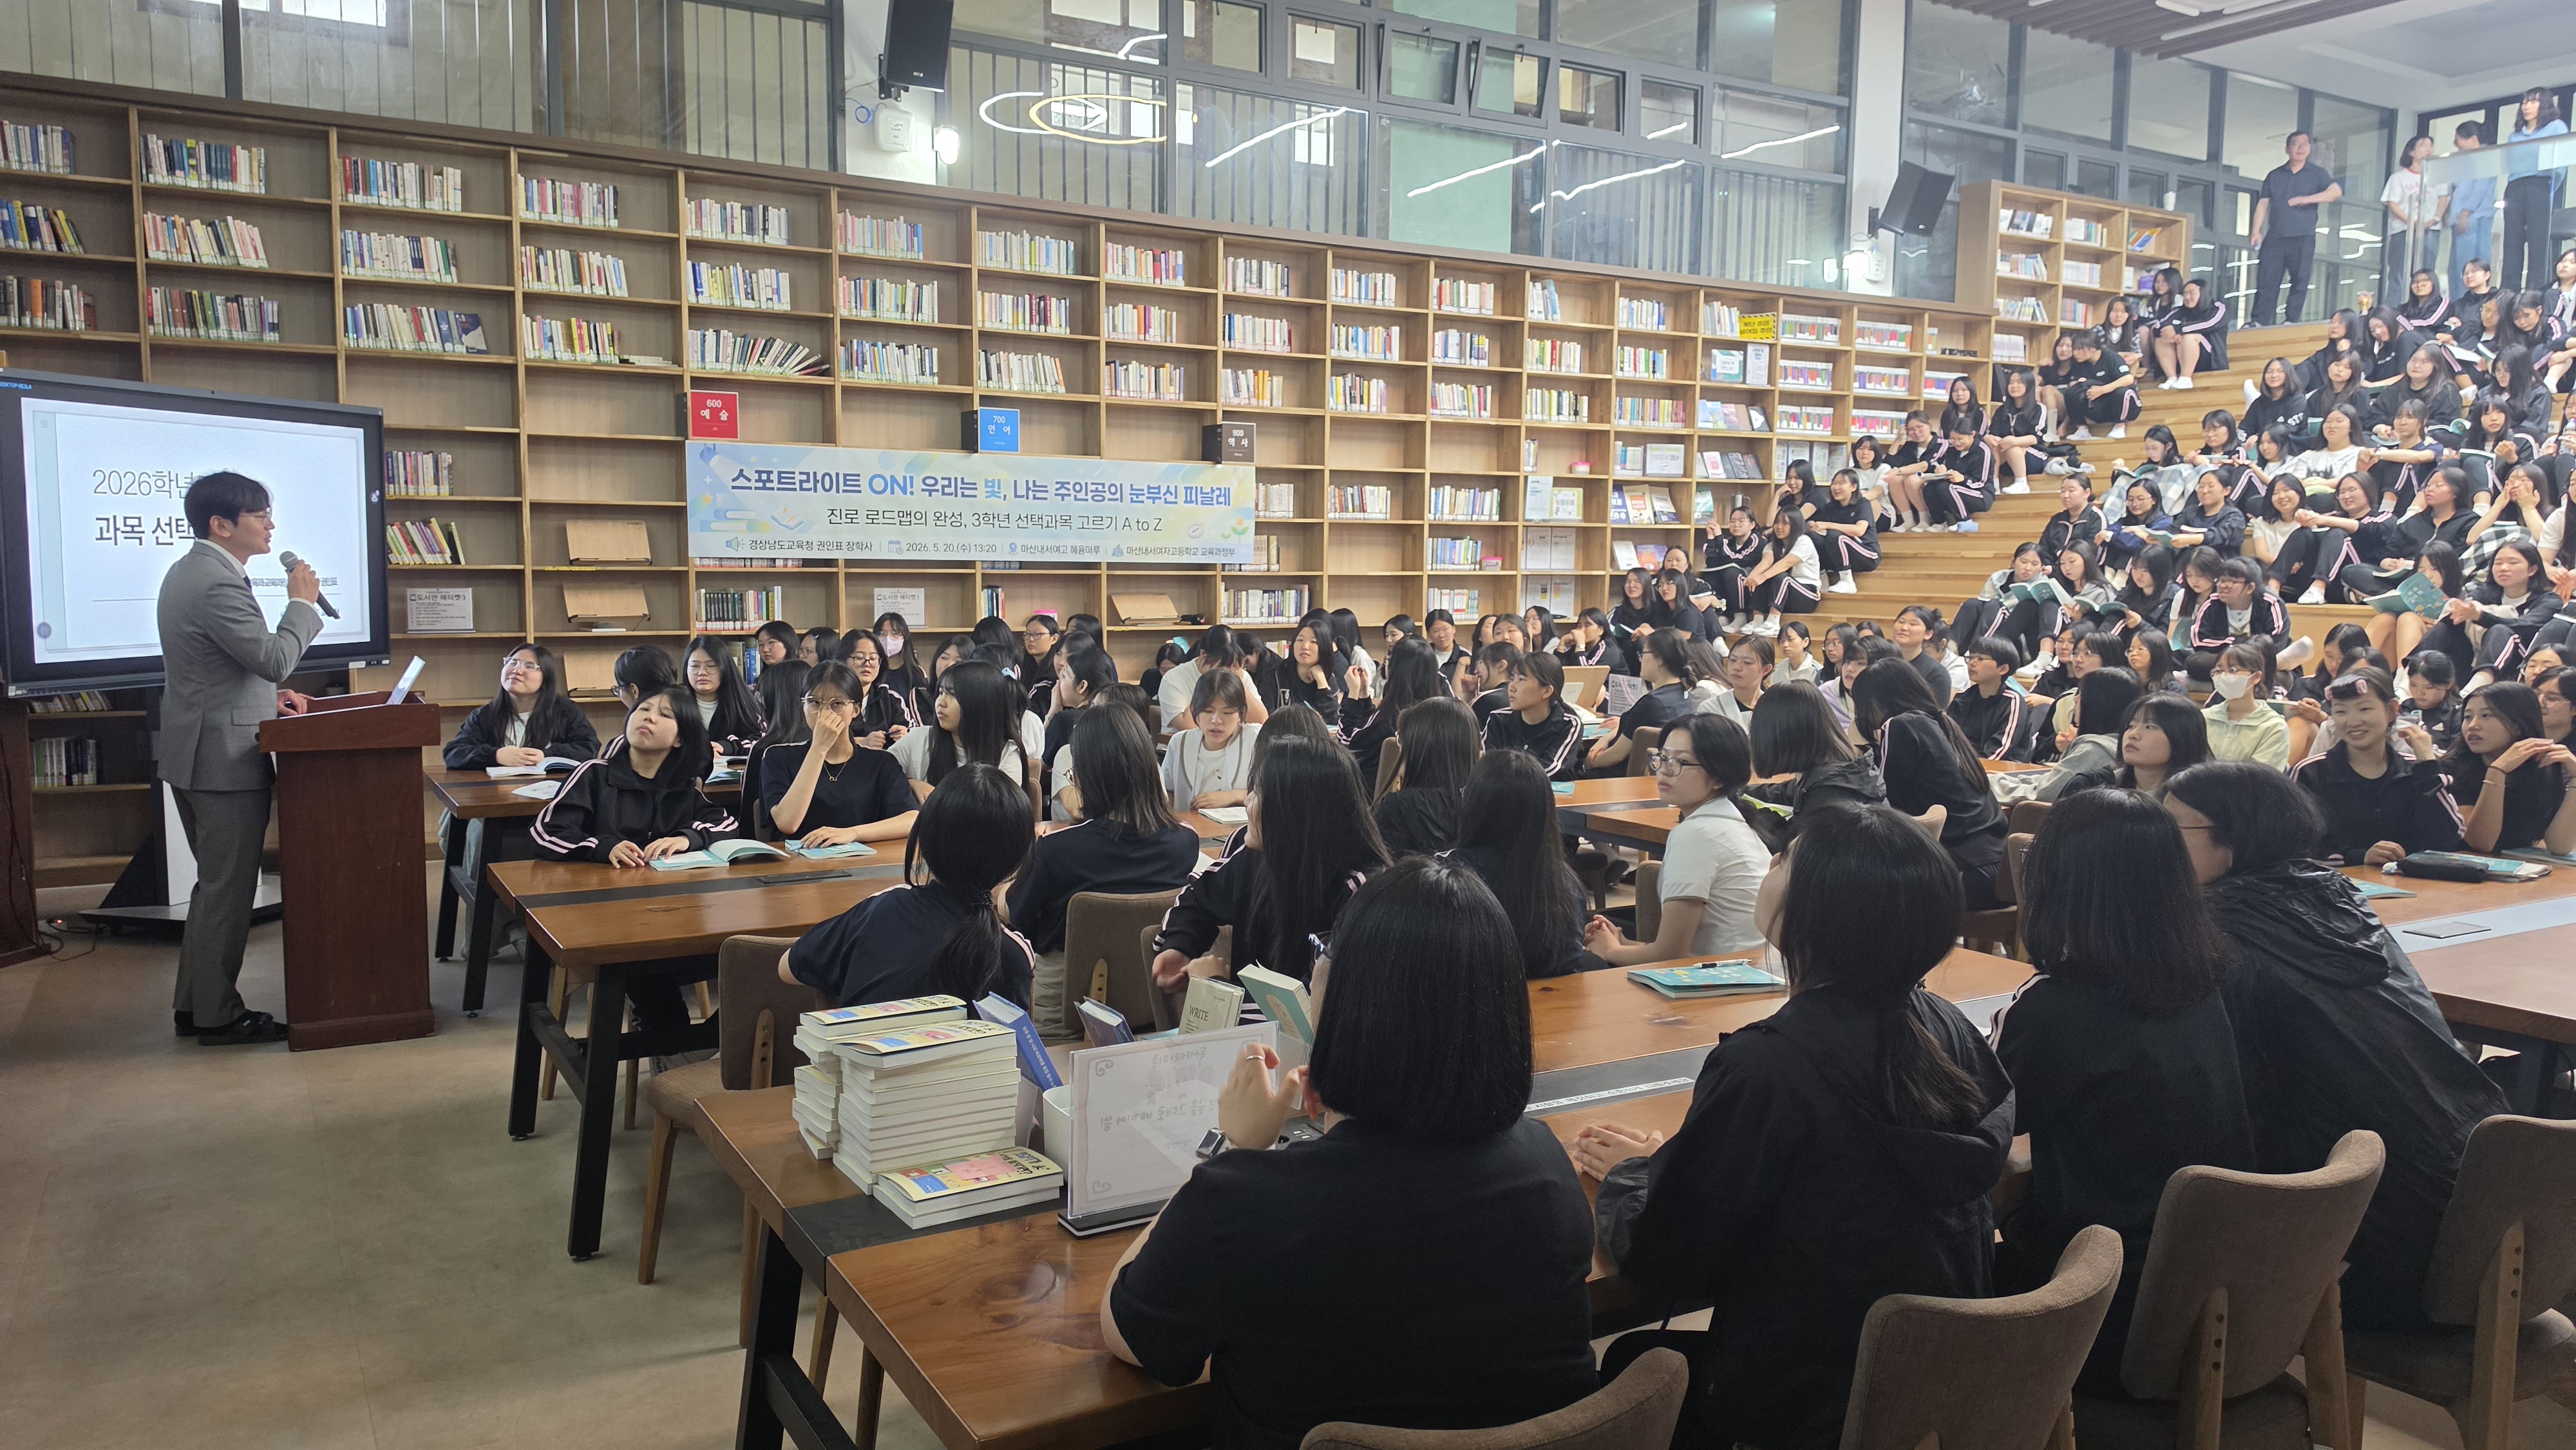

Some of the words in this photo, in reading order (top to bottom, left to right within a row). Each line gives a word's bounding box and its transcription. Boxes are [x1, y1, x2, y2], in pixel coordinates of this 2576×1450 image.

[706, 399, 722, 408] 600
[992, 415, 1006, 424] 700
[987, 424, 996, 435] 언
[1003, 425, 1010, 436] 어
[1227, 437, 1235, 447] 역
[1240, 438, 1249, 447] 사
[93, 469, 193, 499] 2026학년
[730, 468, 862, 496] 스포트라이트
[868, 473, 915, 496] ON!
[920, 475, 978, 499] 우리는
[983, 478, 1007, 502] 빛,
[1013, 478, 1048, 501] 나는
[1054, 480, 1123, 504] 주인공의
[1129, 483, 1178, 505] 눈부신
[1183, 485, 1231, 507] 피날레
[827, 507, 860, 526] 진로
[865, 509, 928, 527] 로드맵의
[933, 511, 967, 529] 완성,
[972, 512, 1010, 530] 3학년
[1015, 513, 1072, 531] 선택과목
[1077, 514, 1118, 531] 고르기
[1121, 517, 1133, 531] A
[1136, 518, 1151, 532] to
[1153, 518, 1163, 531] Z
[95, 514, 146, 546] 과목
[748, 539, 814, 553] 경상남도교육청
[816, 540, 844, 552] 권인표
[846, 540, 873, 553] 장학사
[906, 543, 931, 553] 2026.
[933, 543, 941, 553] 5.
[942, 543, 972, 554] 20.(수)
[973, 543, 997, 553] 13:20
[1021, 544, 1068, 555] 마산내서여고
[1126, 545, 1199, 556] 마산내서여자고등학교
[1200, 546, 1235, 557] 교육과정부
[1189, 1005, 1209, 1022] WRITE
